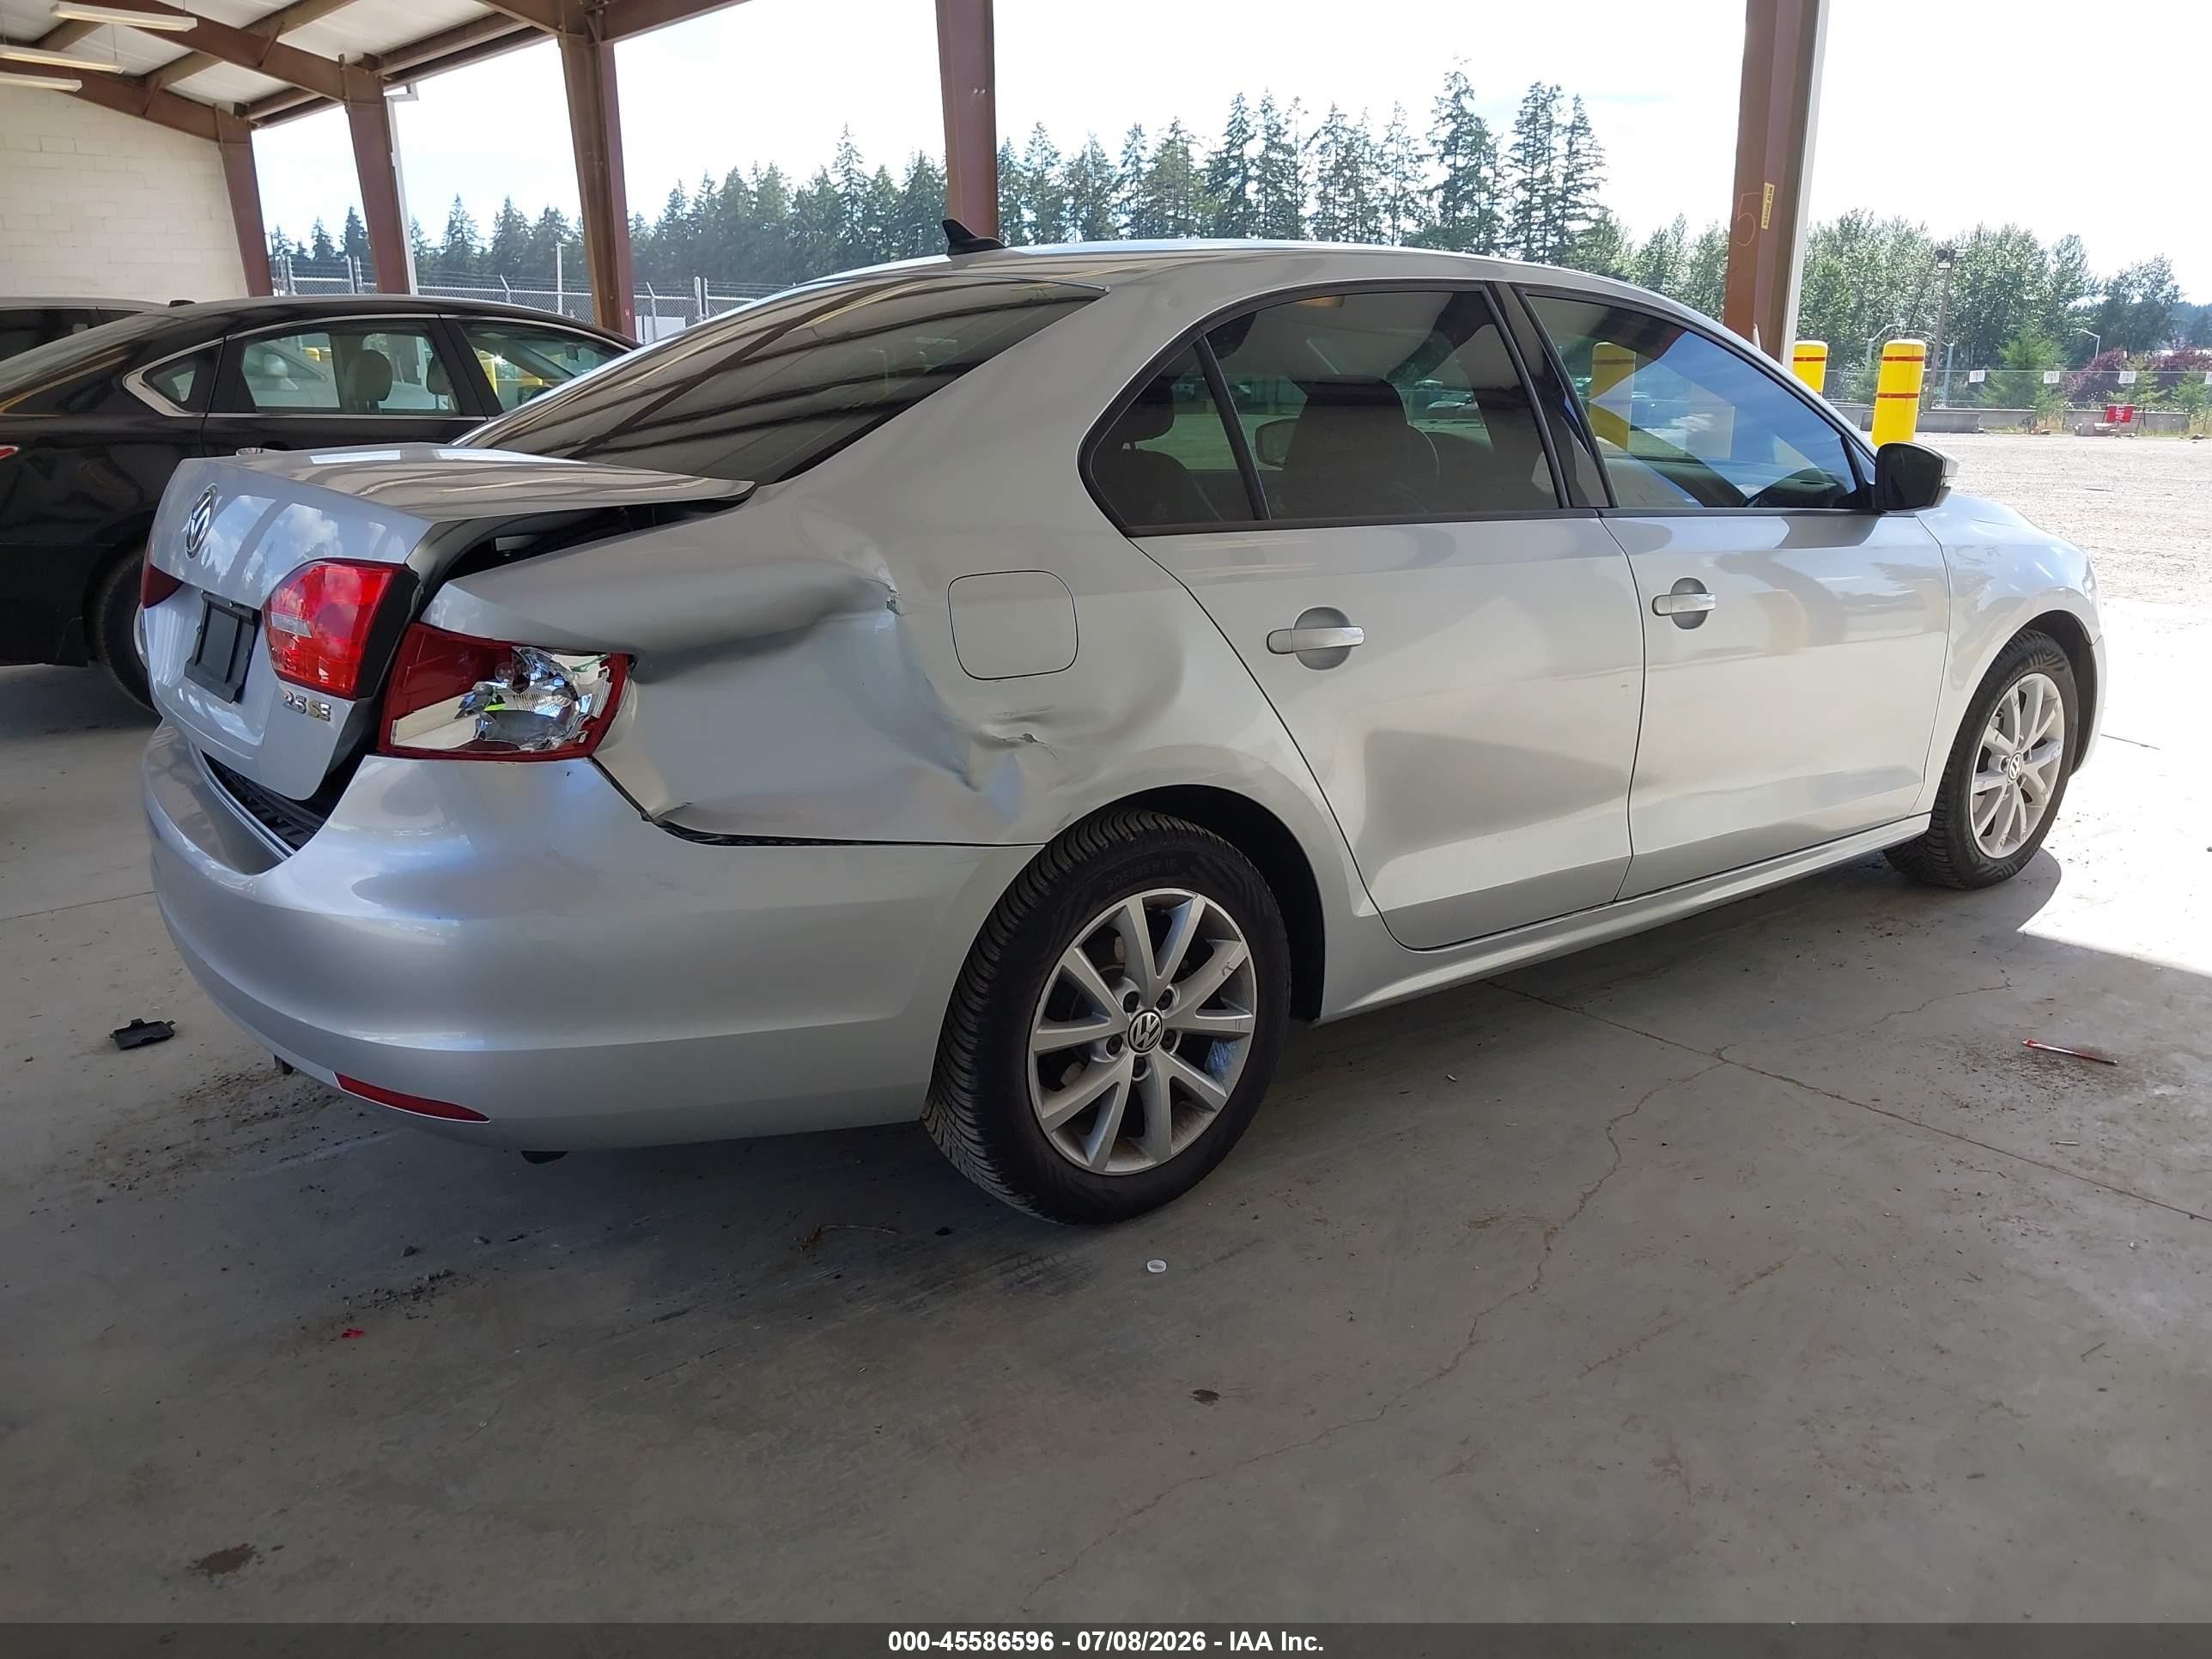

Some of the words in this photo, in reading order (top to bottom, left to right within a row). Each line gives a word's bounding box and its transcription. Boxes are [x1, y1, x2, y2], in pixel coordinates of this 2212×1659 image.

[1736, 191, 1762, 246] 5
[308, 700, 331, 722] SE
[1129, 1012, 1162, 1052] VW
